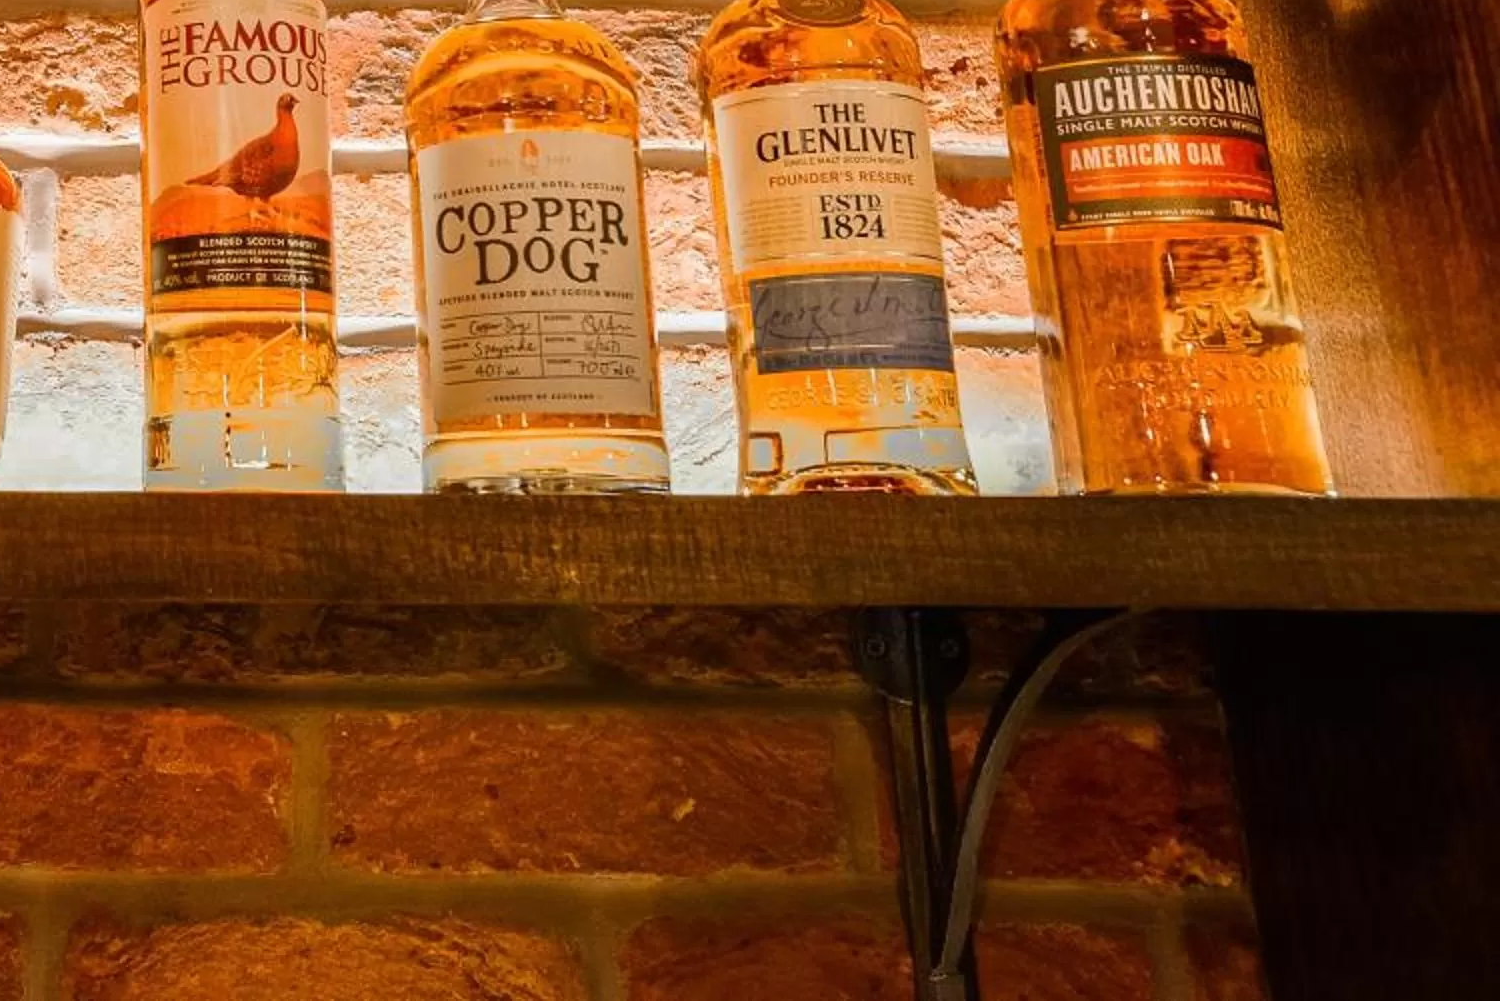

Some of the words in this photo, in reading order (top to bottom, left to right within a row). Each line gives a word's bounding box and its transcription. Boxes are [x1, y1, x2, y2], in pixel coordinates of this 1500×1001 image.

[184, 19, 327, 65] FAMOUS
[160, 25, 181, 94] THE
[1108, 66, 1131, 75] THE
[1135, 64, 1173, 73] TRIPLE
[1177, 64, 1228, 76] DISTILLED
[1055, 74, 1261, 119] AUCHENTOSHAN
[813, 102, 867, 123] THE
[1057, 118, 1116, 135] SINGLE
[1121, 116, 1163, 128] MALT
[1168, 115, 1228, 128] SCOTCH
[756, 127, 917, 163] GLENLIVET
[1070, 143, 1181, 172] AMERICAN
[1186, 143, 1226, 166] OAK
[769, 170, 854, 188] FOUNDER'S
[859, 170, 916, 187] RESERVE
[436, 197, 628, 254] COPPER
[822, 214, 885, 240] 1824
[200, 237, 243, 248] BLENDED
[246, 236, 285, 247] SCOTCH
[474, 236, 600, 286] DOG
[206, 272, 251, 283] PRODUCT
